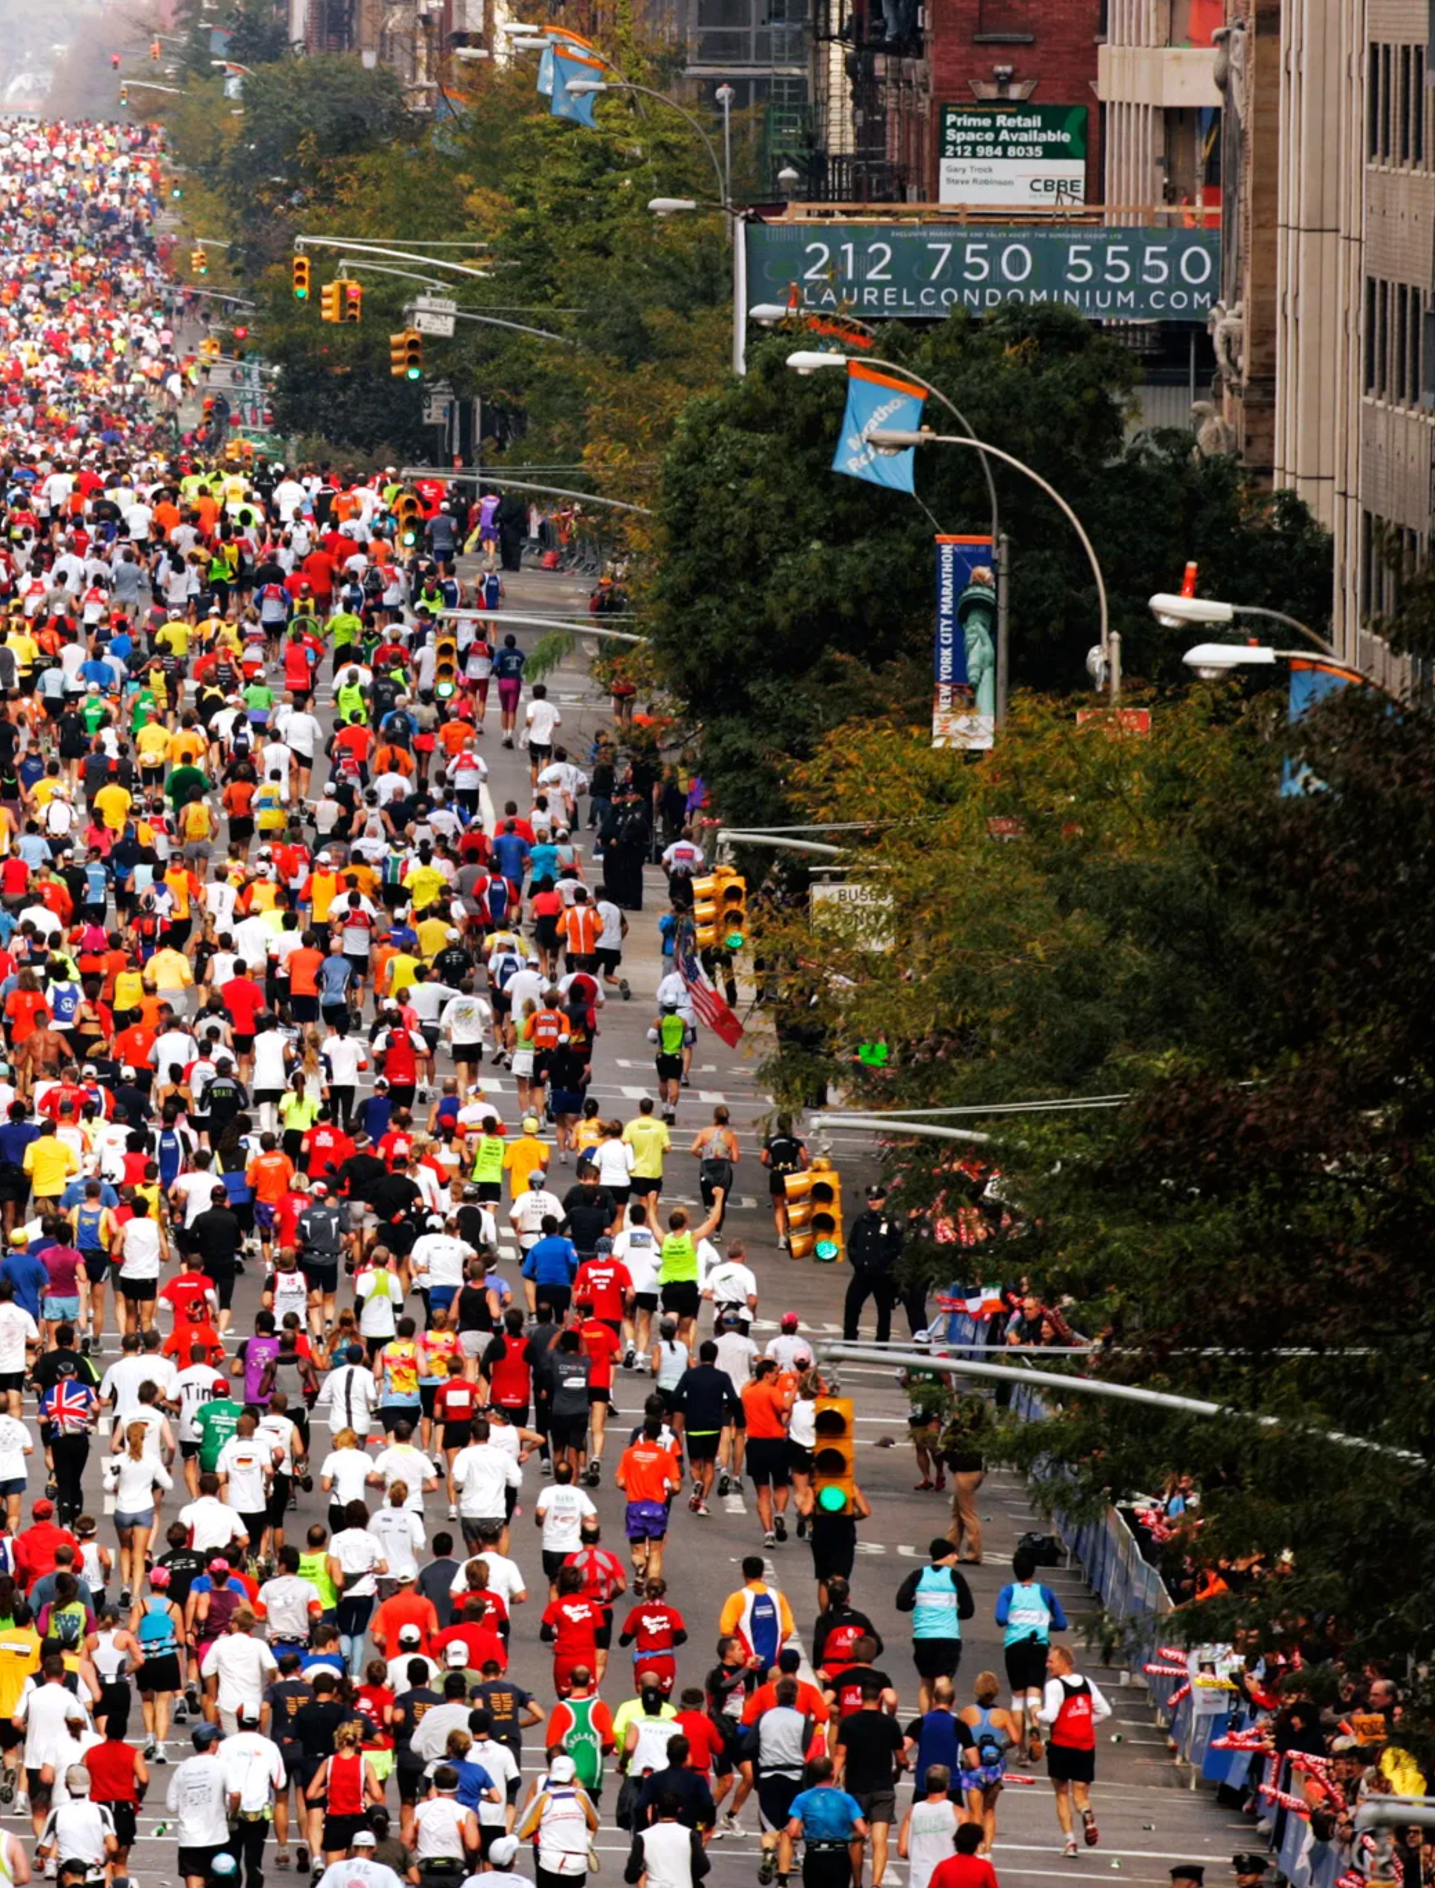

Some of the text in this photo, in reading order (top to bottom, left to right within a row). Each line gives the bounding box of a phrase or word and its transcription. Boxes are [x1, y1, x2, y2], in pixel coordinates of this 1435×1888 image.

[945, 114, 1042, 128] Prime Retail
[945, 128, 1071, 144] Space Available
[945, 145, 1043, 158] 212 984 8035
[1029, 178, 1082, 193] CBRE
[803, 242, 1212, 284] 212 750 5550
[803, 287, 1211, 309] LAURELCONDOMINIUM.COM
[940, 544, 954, 615] MARATHON
[940, 617, 954, 646] CITY
[939, 648, 954, 683] YORK
